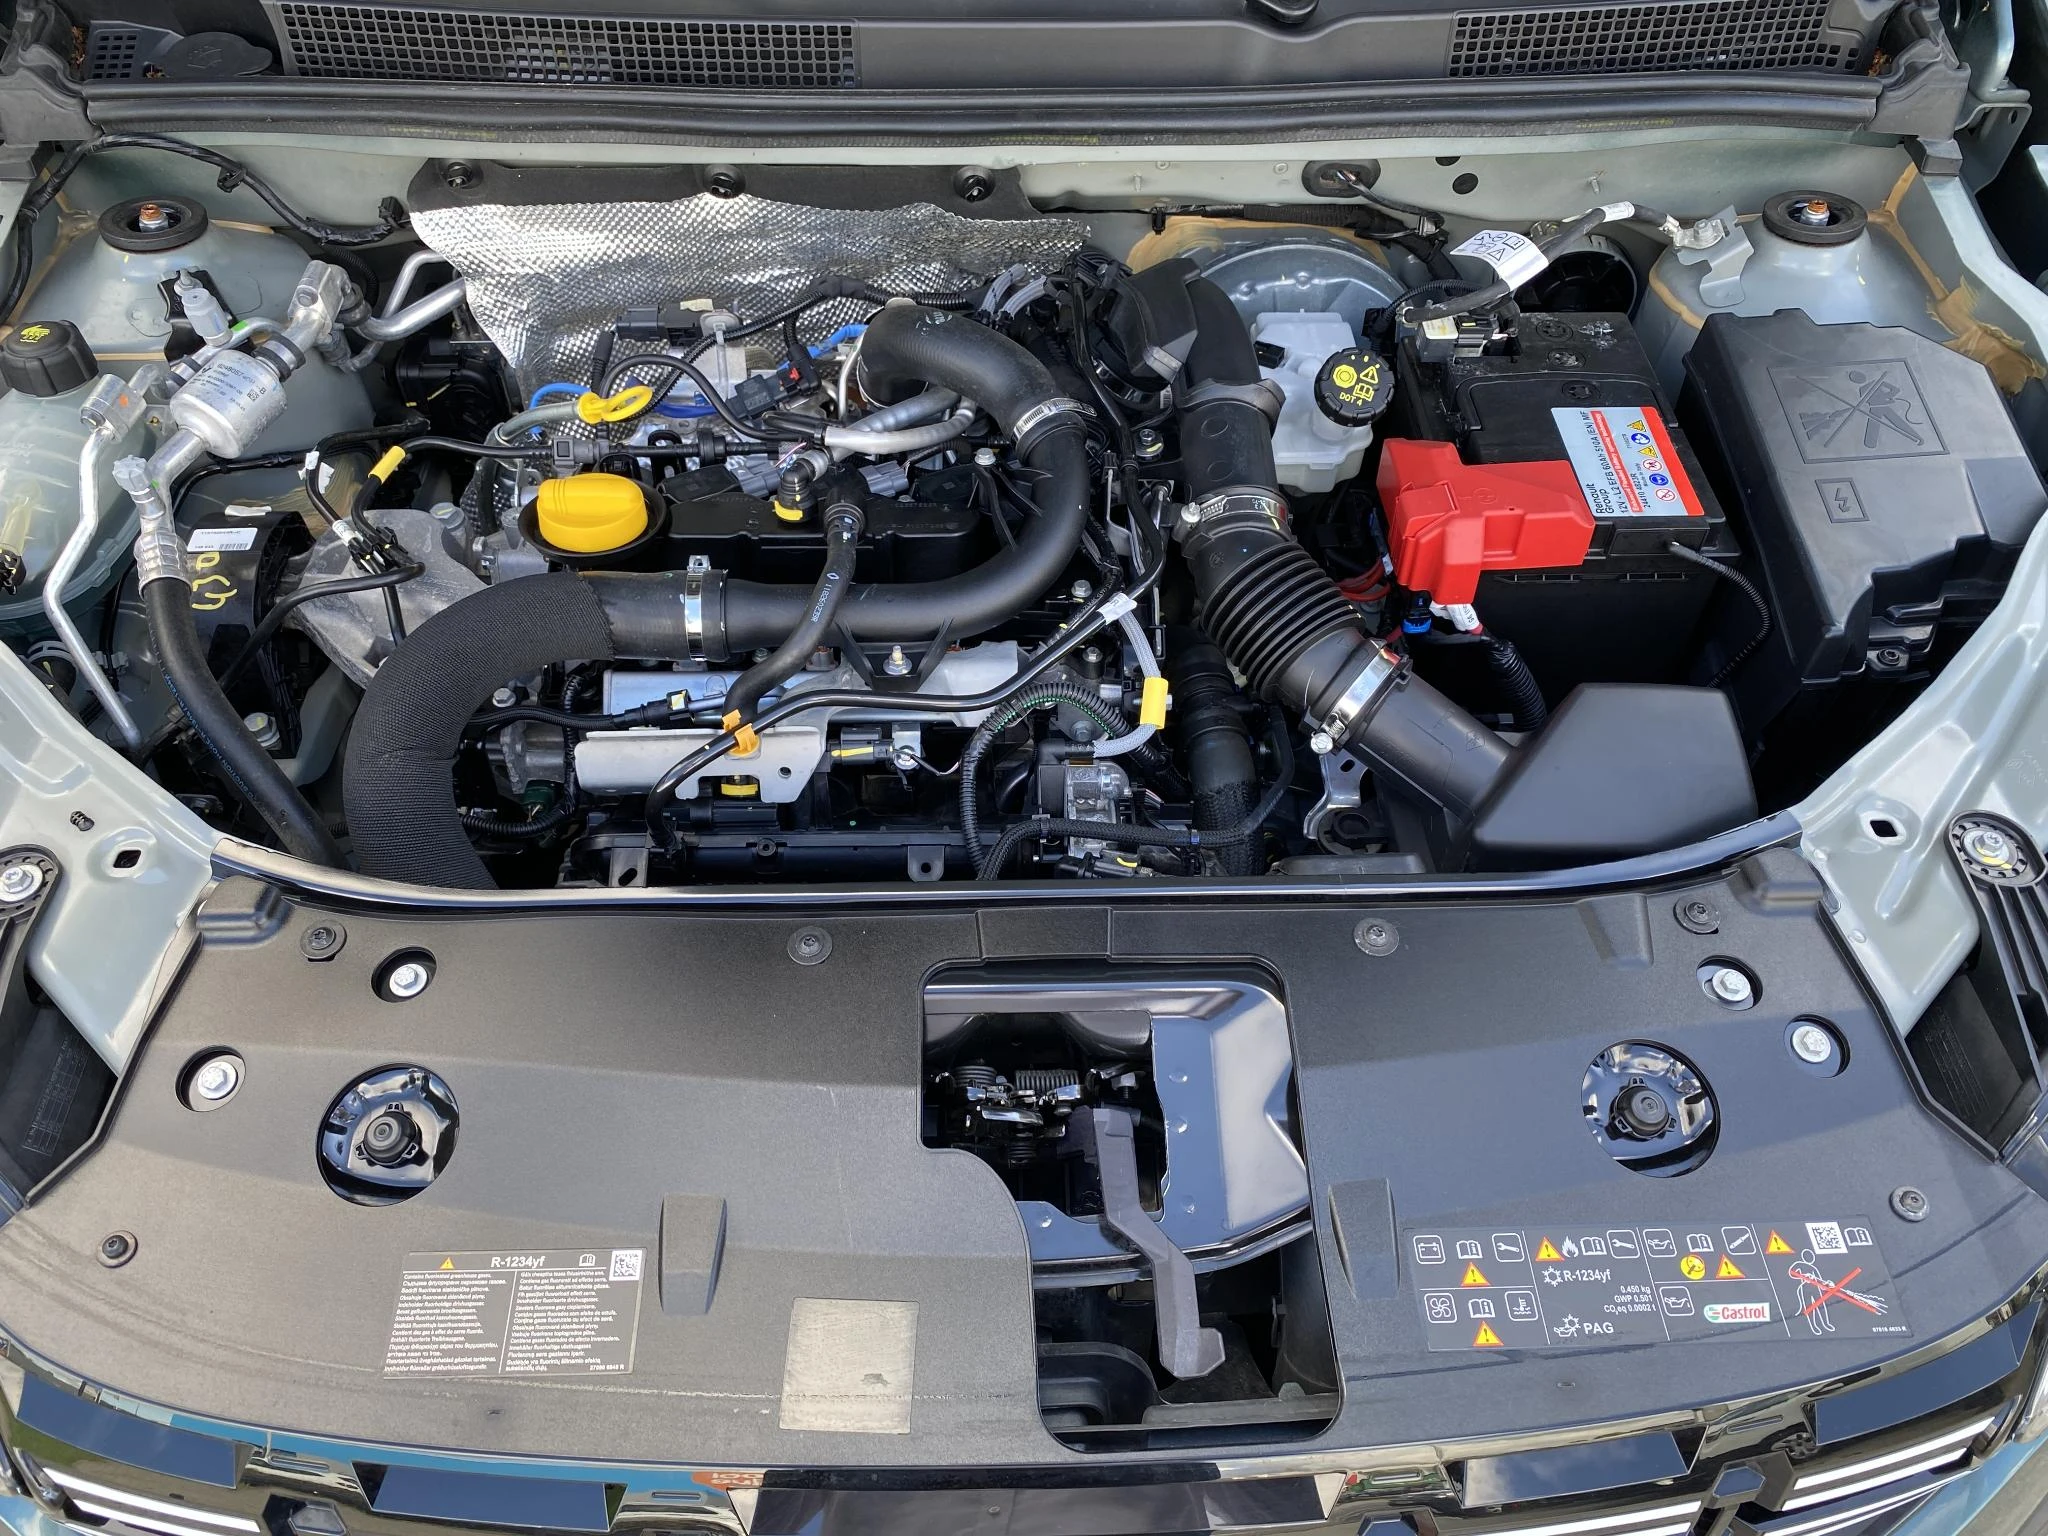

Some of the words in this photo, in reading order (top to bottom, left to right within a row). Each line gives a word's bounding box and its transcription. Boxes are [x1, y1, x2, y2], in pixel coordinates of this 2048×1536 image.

[1340, 392, 1356, 403] DOT
[1580, 411, 1591, 420] MF
[1584, 423, 1597, 435] (EN)
[1591, 436, 1603, 453] 510A
[1598, 453, 1610, 470] 60Ah
[1606, 471, 1617, 485] EFB
[1612, 484, 1621, 495] L2
[1586, 483, 1605, 513] Renault
[1599, 489, 1614, 513] Group
[1617, 501, 1628, 514] 12V
[491, 1256, 546, 1269] R-1234yf
[1563, 1269, 1611, 1283] R-1234yf
[1620, 1285, 1639, 1293] 0.450
[1641, 1285, 1651, 1294] kg
[1614, 1295, 1632, 1303] GWP
[1721, 1305, 1767, 1320] Castrol
[1583, 1322, 1614, 1334] PAG
